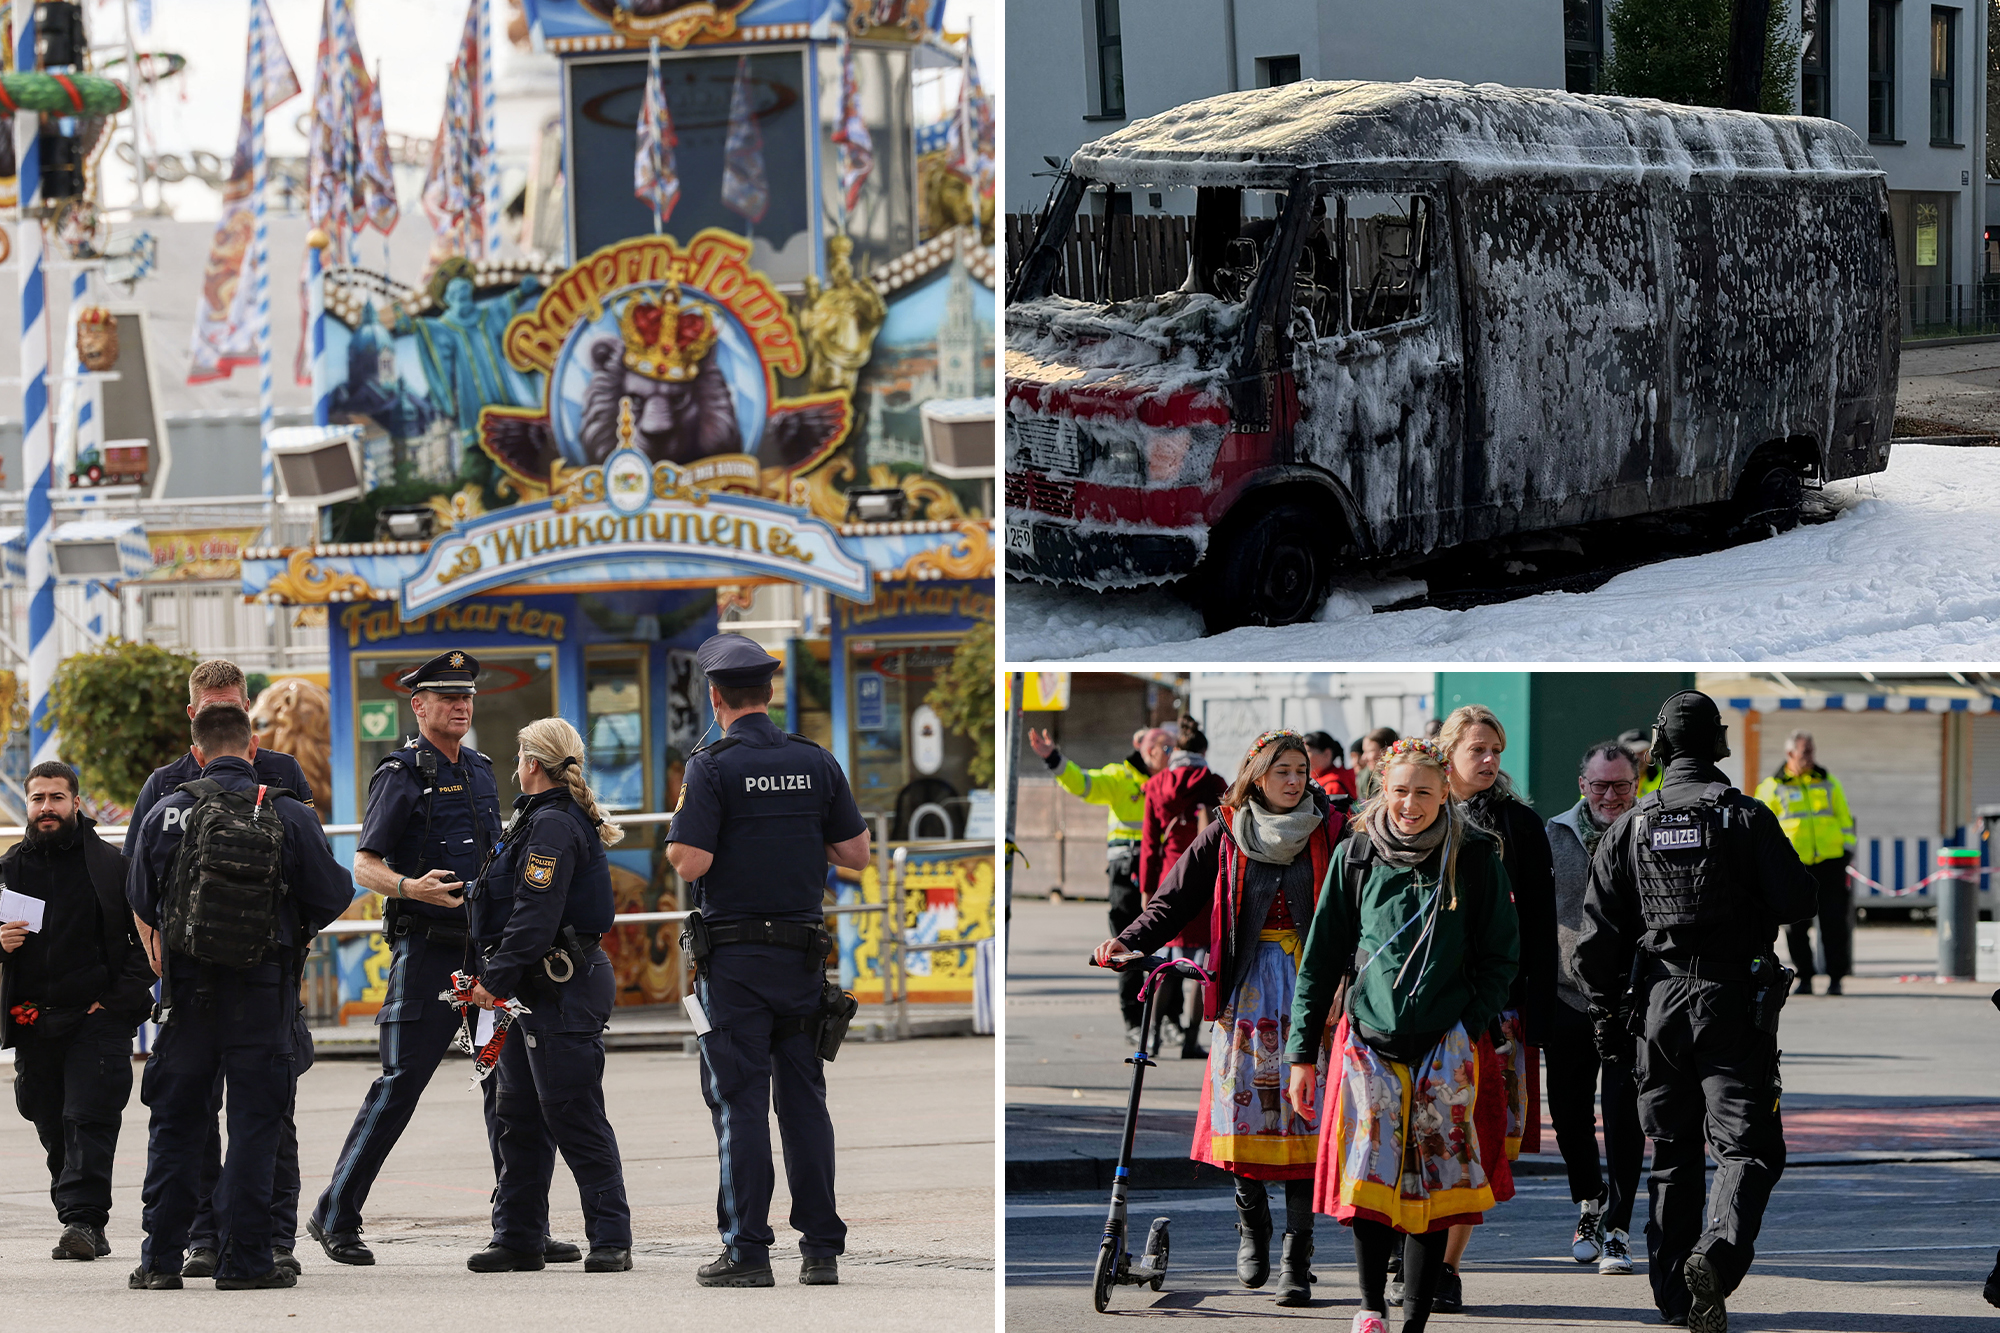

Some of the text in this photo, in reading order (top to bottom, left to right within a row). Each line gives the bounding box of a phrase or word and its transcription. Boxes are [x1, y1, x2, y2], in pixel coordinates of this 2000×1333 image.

[508, 238, 802, 374] Bayern Tower
[484, 509, 762, 563] Willkommen
[438, 784, 463, 793] POLIZEI
[745, 774, 812, 793] POLIZEI
[1660, 813, 1689, 823] 23-04
[1653, 828, 1698, 847] POLIZEI
[530, 856, 554, 867] POLIZEI
